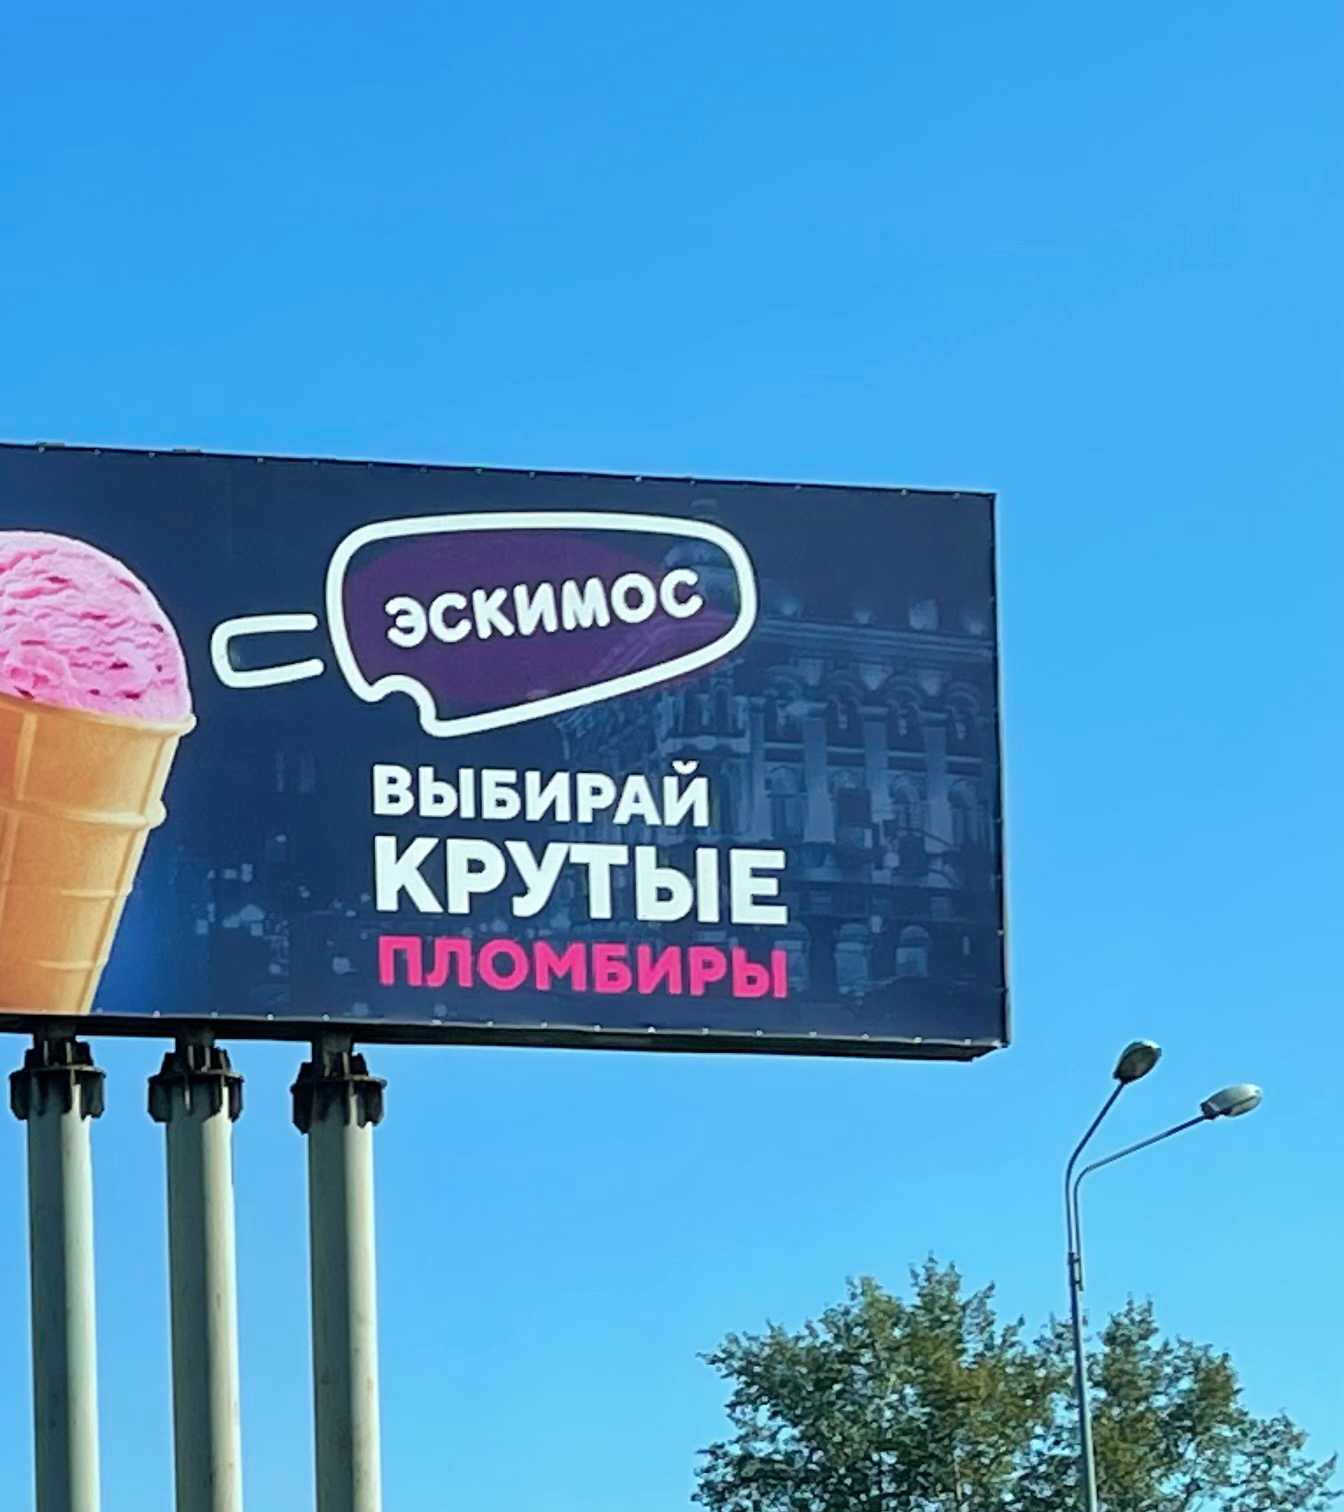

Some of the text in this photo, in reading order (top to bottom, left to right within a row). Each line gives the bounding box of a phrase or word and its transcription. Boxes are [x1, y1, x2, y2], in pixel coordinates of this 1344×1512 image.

[384, 568, 704, 648] ЭСКИМОС
[373, 760, 709, 827] ВЫБИРАЙ
[374, 835, 788, 925] КРУТЫЕ
[378, 936, 788, 999] ПЛОМБИРЫ
